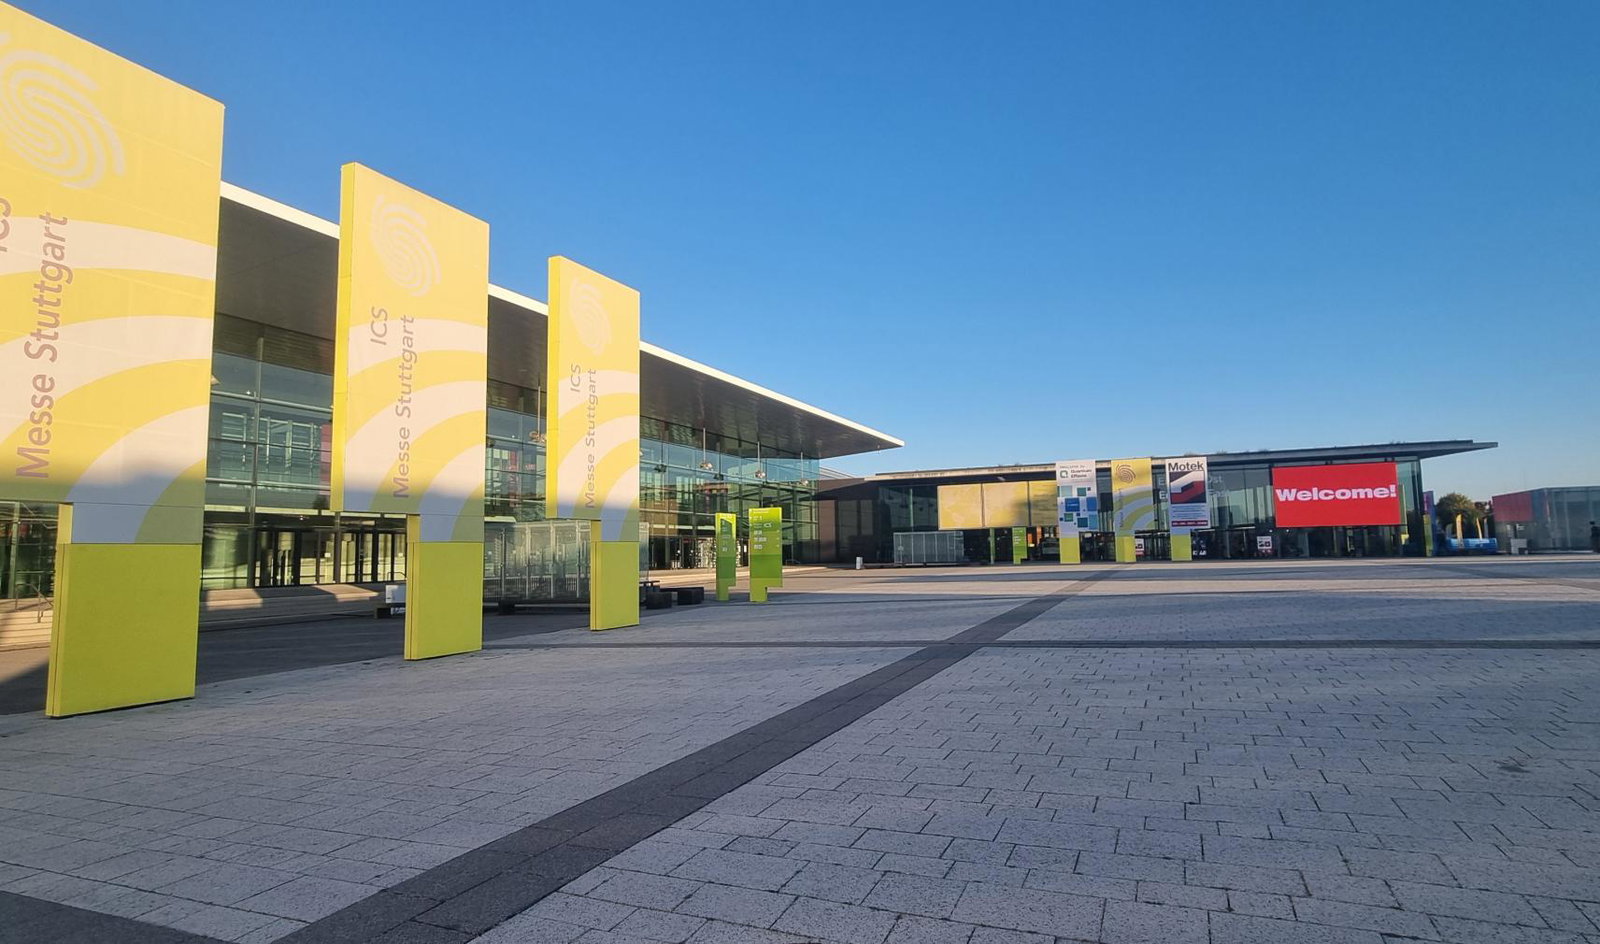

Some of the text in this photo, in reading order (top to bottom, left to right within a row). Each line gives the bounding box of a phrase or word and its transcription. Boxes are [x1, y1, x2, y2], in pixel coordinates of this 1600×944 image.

[15, 212, 73, 478] Messe Stuttgart
[370, 306, 388, 346] ICS
[570, 363, 581, 393] ICS
[393, 314, 417, 499] Messe Stuttgart
[585, 368, 598, 509] Messe Stuttgart
[1168, 461, 1204, 471] Motek
[1276, 484, 1397, 502] Welcome!
